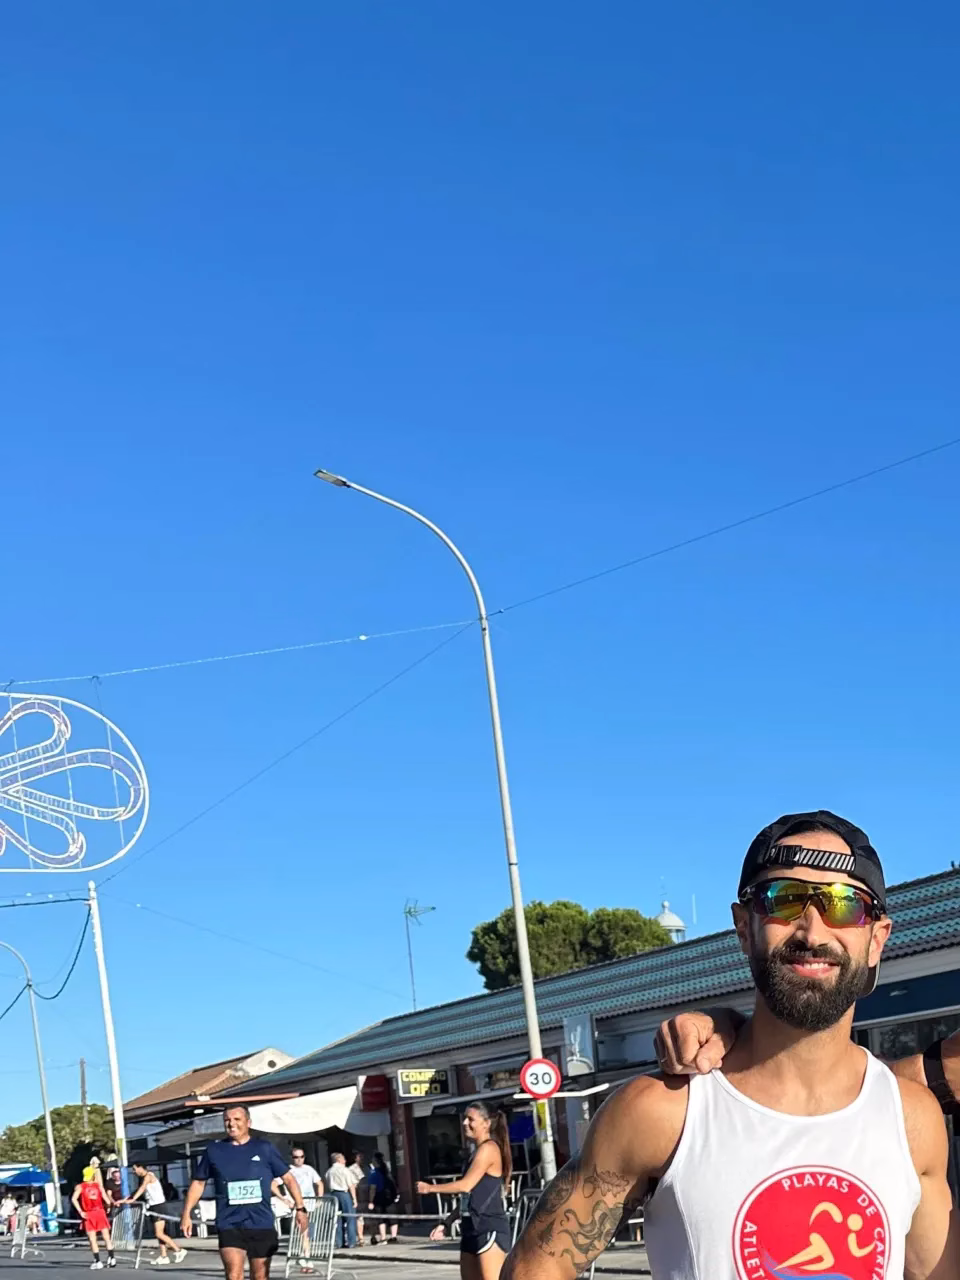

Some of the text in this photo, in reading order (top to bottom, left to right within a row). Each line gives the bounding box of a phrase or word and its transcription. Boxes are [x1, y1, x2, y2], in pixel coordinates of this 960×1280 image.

[402, 1072, 446, 1082] COMPRO
[529, 1072, 552, 1086] 30
[410, 1083, 441, 1094] ORO
[238, 1186, 255, 1196] 152
[781, 1173, 850, 1193] PLAYAS
[857, 1194, 877, 1217] DE
